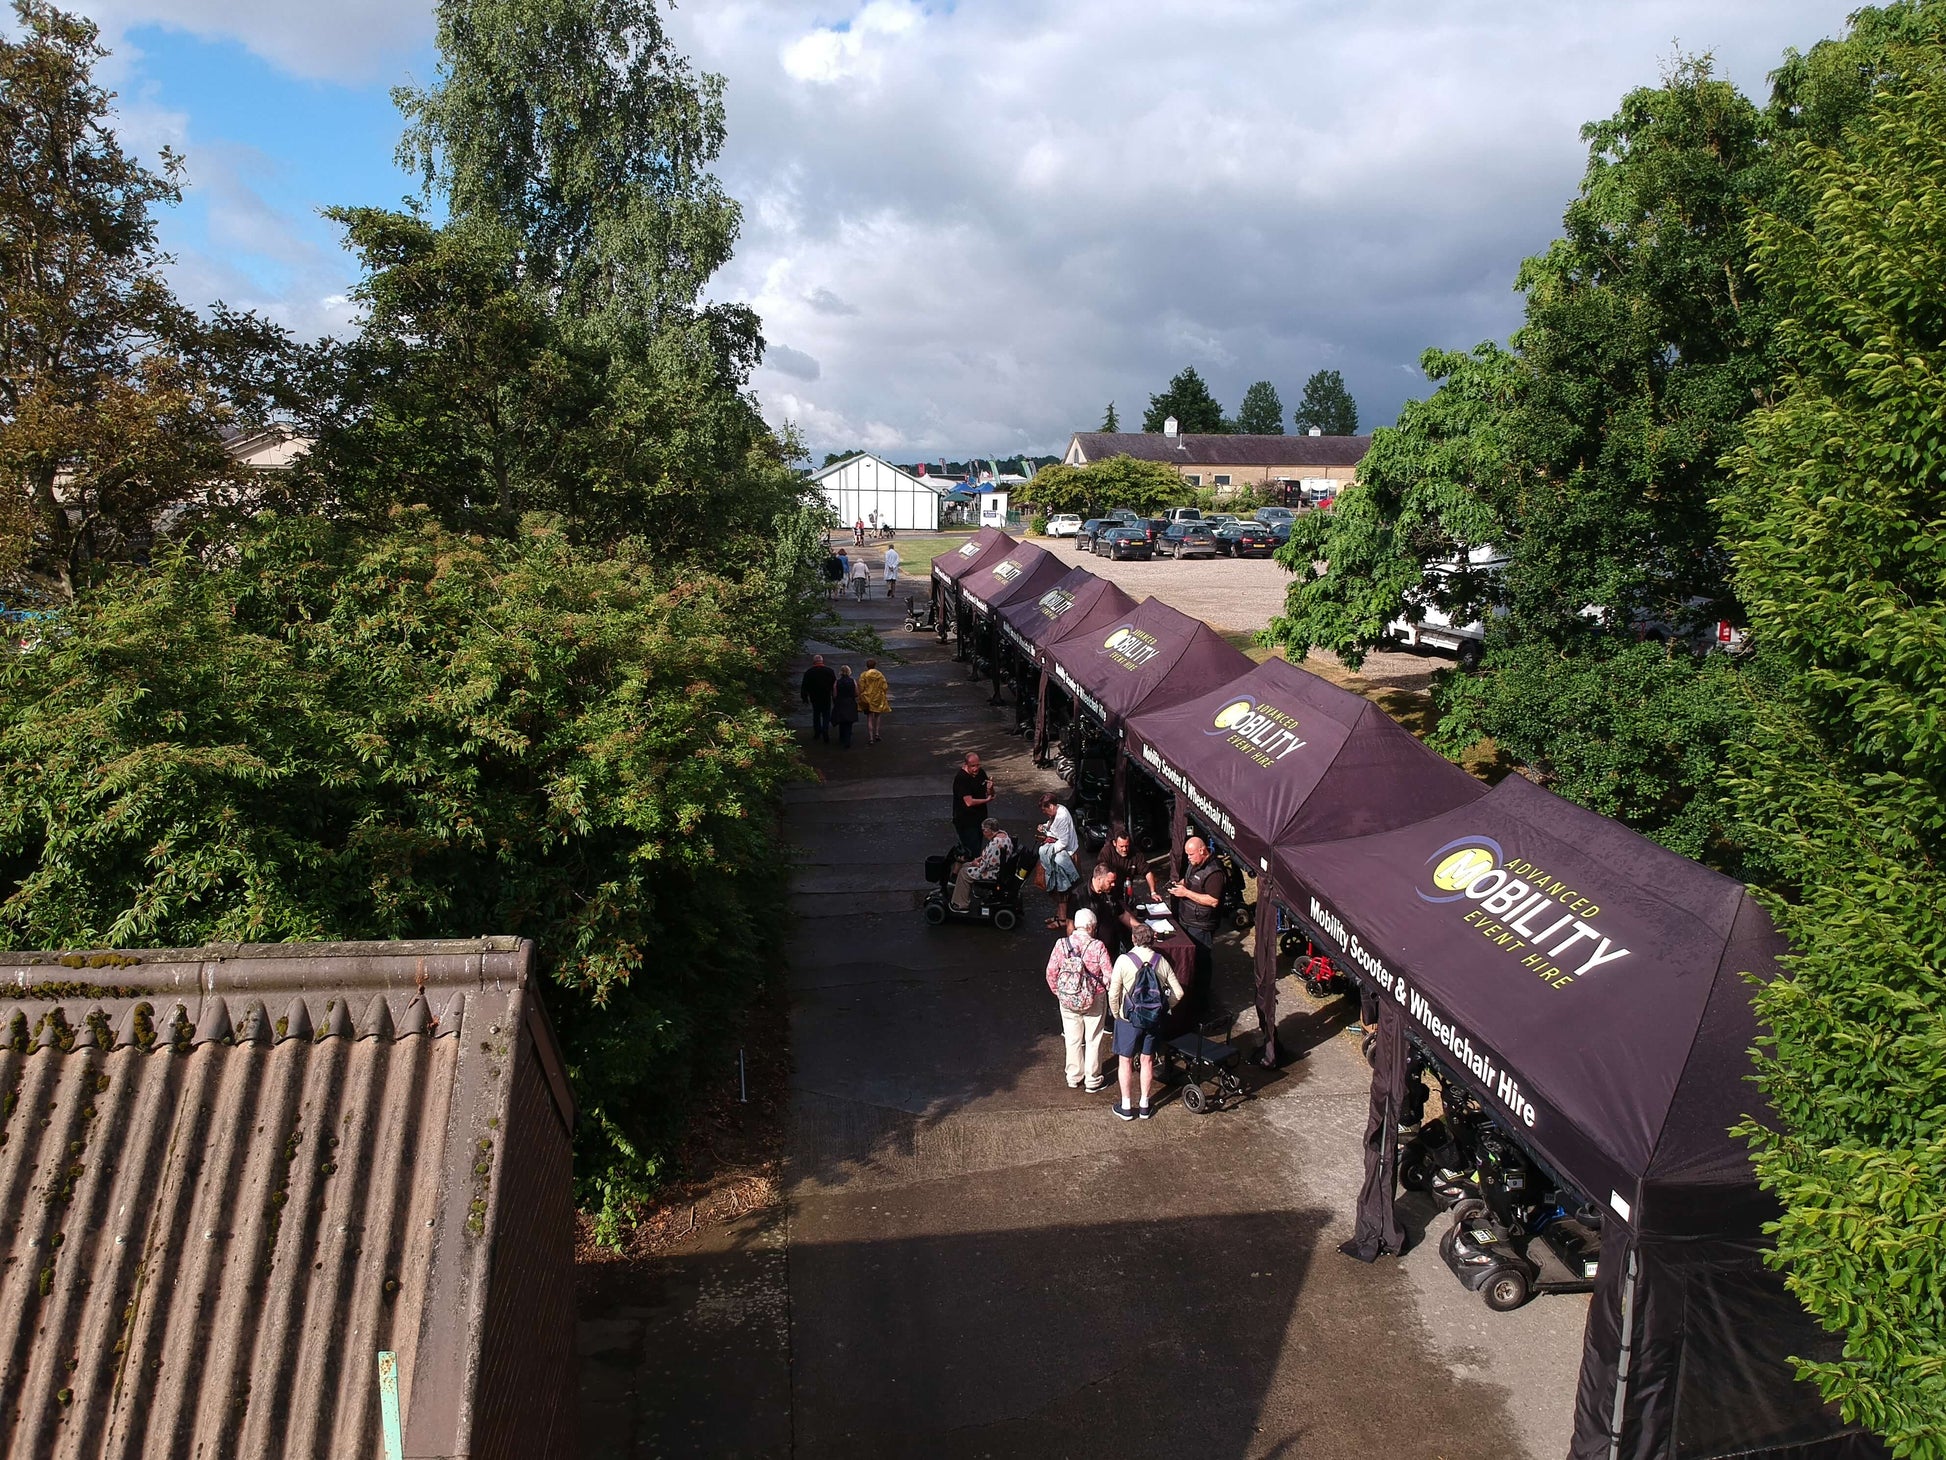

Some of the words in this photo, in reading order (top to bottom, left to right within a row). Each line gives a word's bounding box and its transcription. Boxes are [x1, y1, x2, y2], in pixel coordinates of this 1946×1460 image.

[1226, 734, 1256, 754] EVENT
[1250, 751, 1275, 768] HIRE
[1254, 703, 1299, 730] ADVANCED
[1142, 743, 1162, 773] Mobility
[1161, 758, 1181, 788] Scooter
[1181, 776, 1188, 794] &
[1187, 781, 1221, 825] Wheelchair
[1221, 812, 1236, 840] Hire
[1436, 850, 1631, 977] MOBILITY
[1503, 858, 1600, 919] ADVANCED
[1463, 909, 1526, 952] EVENT
[1520, 952, 1575, 990] HIRE
[1310, 896, 1349, 954] Mobility
[1350, 934, 1394, 992] Scooter
[1394, 976, 1407, 1006] &
[1409, 987, 1497, 1089] Wheelchair
[1497, 1069, 1536, 1129] Hire
